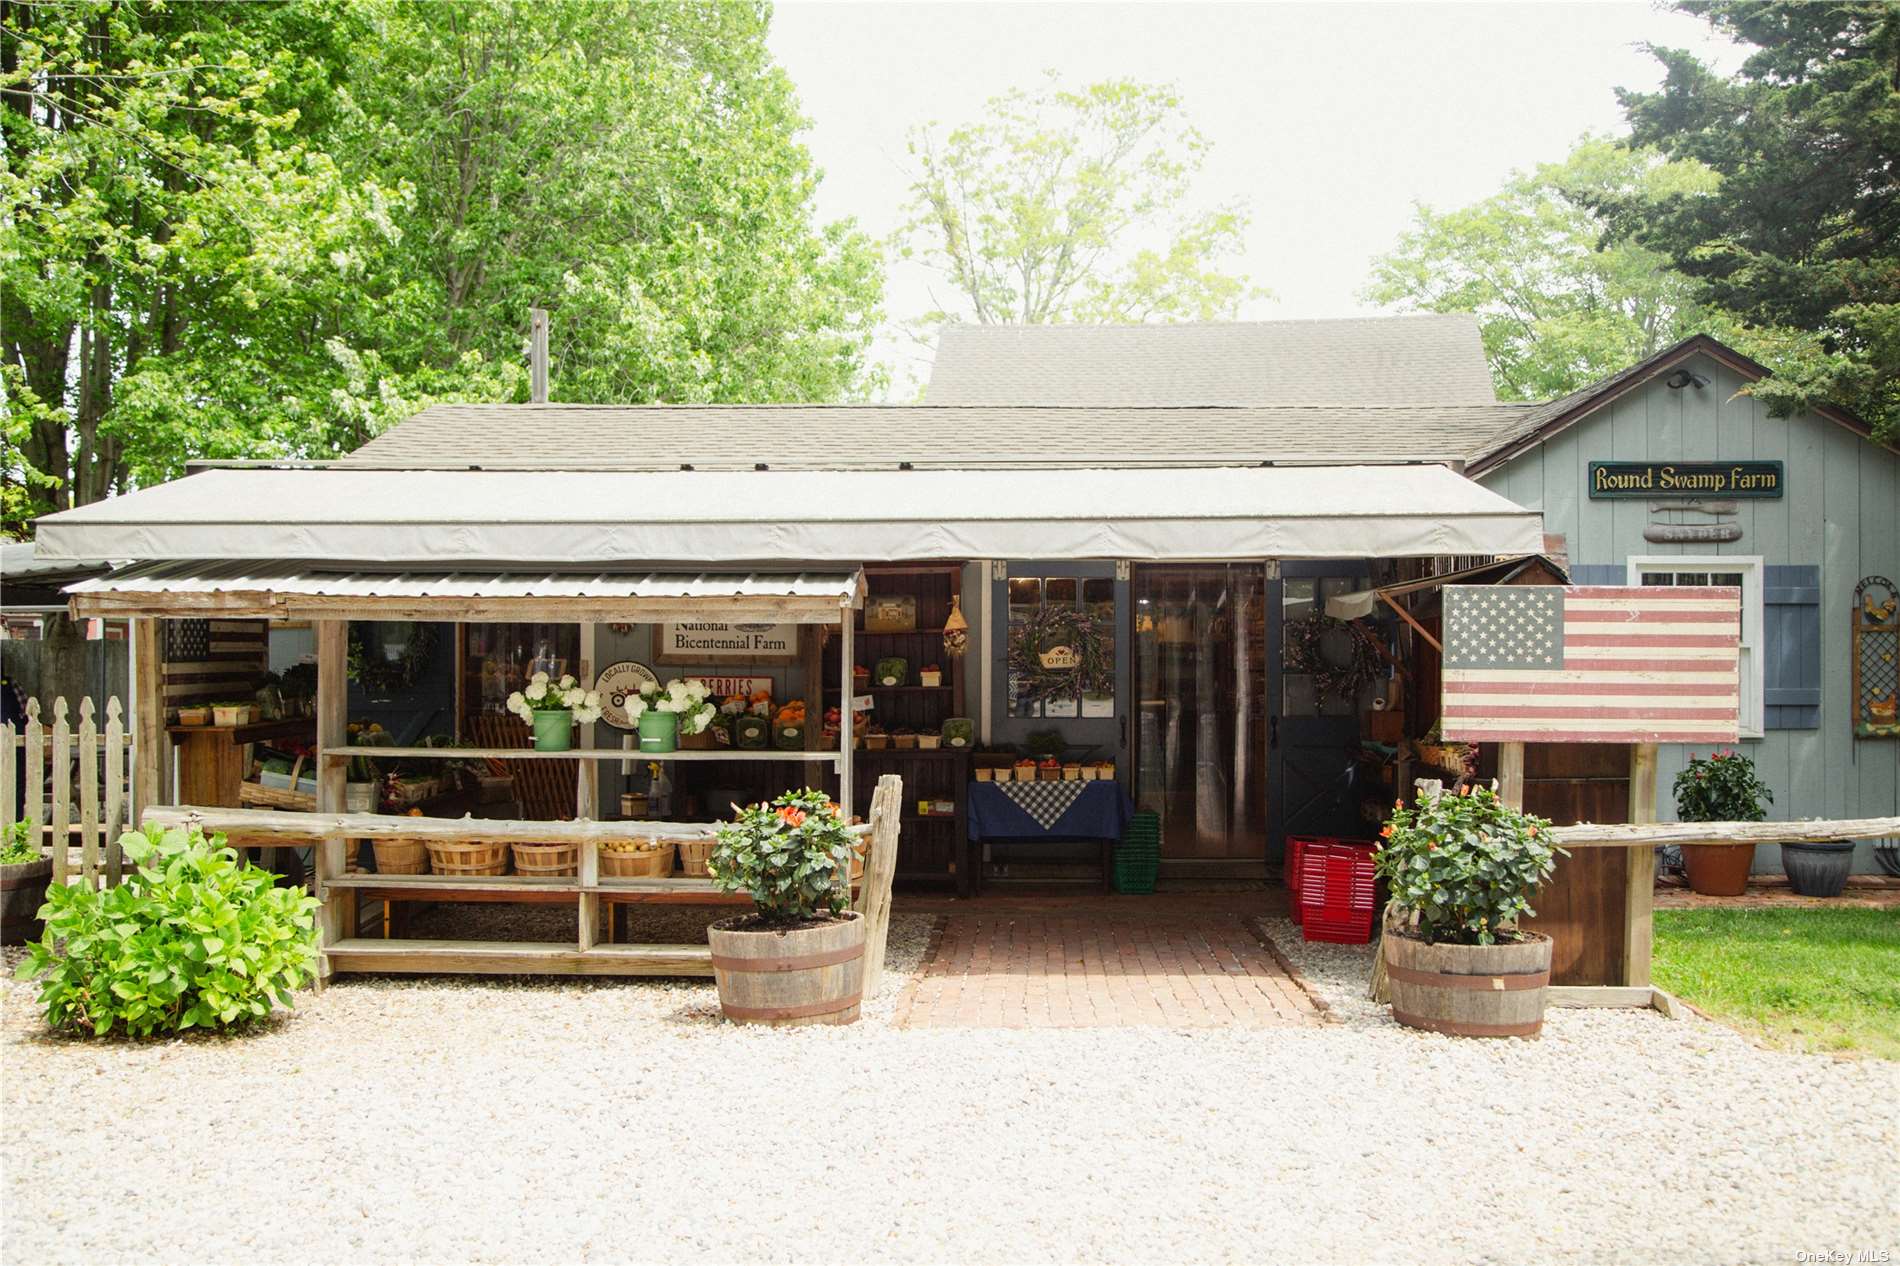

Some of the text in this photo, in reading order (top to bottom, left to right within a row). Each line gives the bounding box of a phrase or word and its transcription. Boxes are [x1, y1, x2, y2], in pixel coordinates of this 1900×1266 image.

[1596, 466, 1777, 492] Round Swamp Farm
[675, 623, 728, 631] National
[675, 634, 786, 650] Bicentennial Farm
[1047, 656, 1076, 665] OPEN
[601, 664, 655, 683] LOCALLY GROWN
